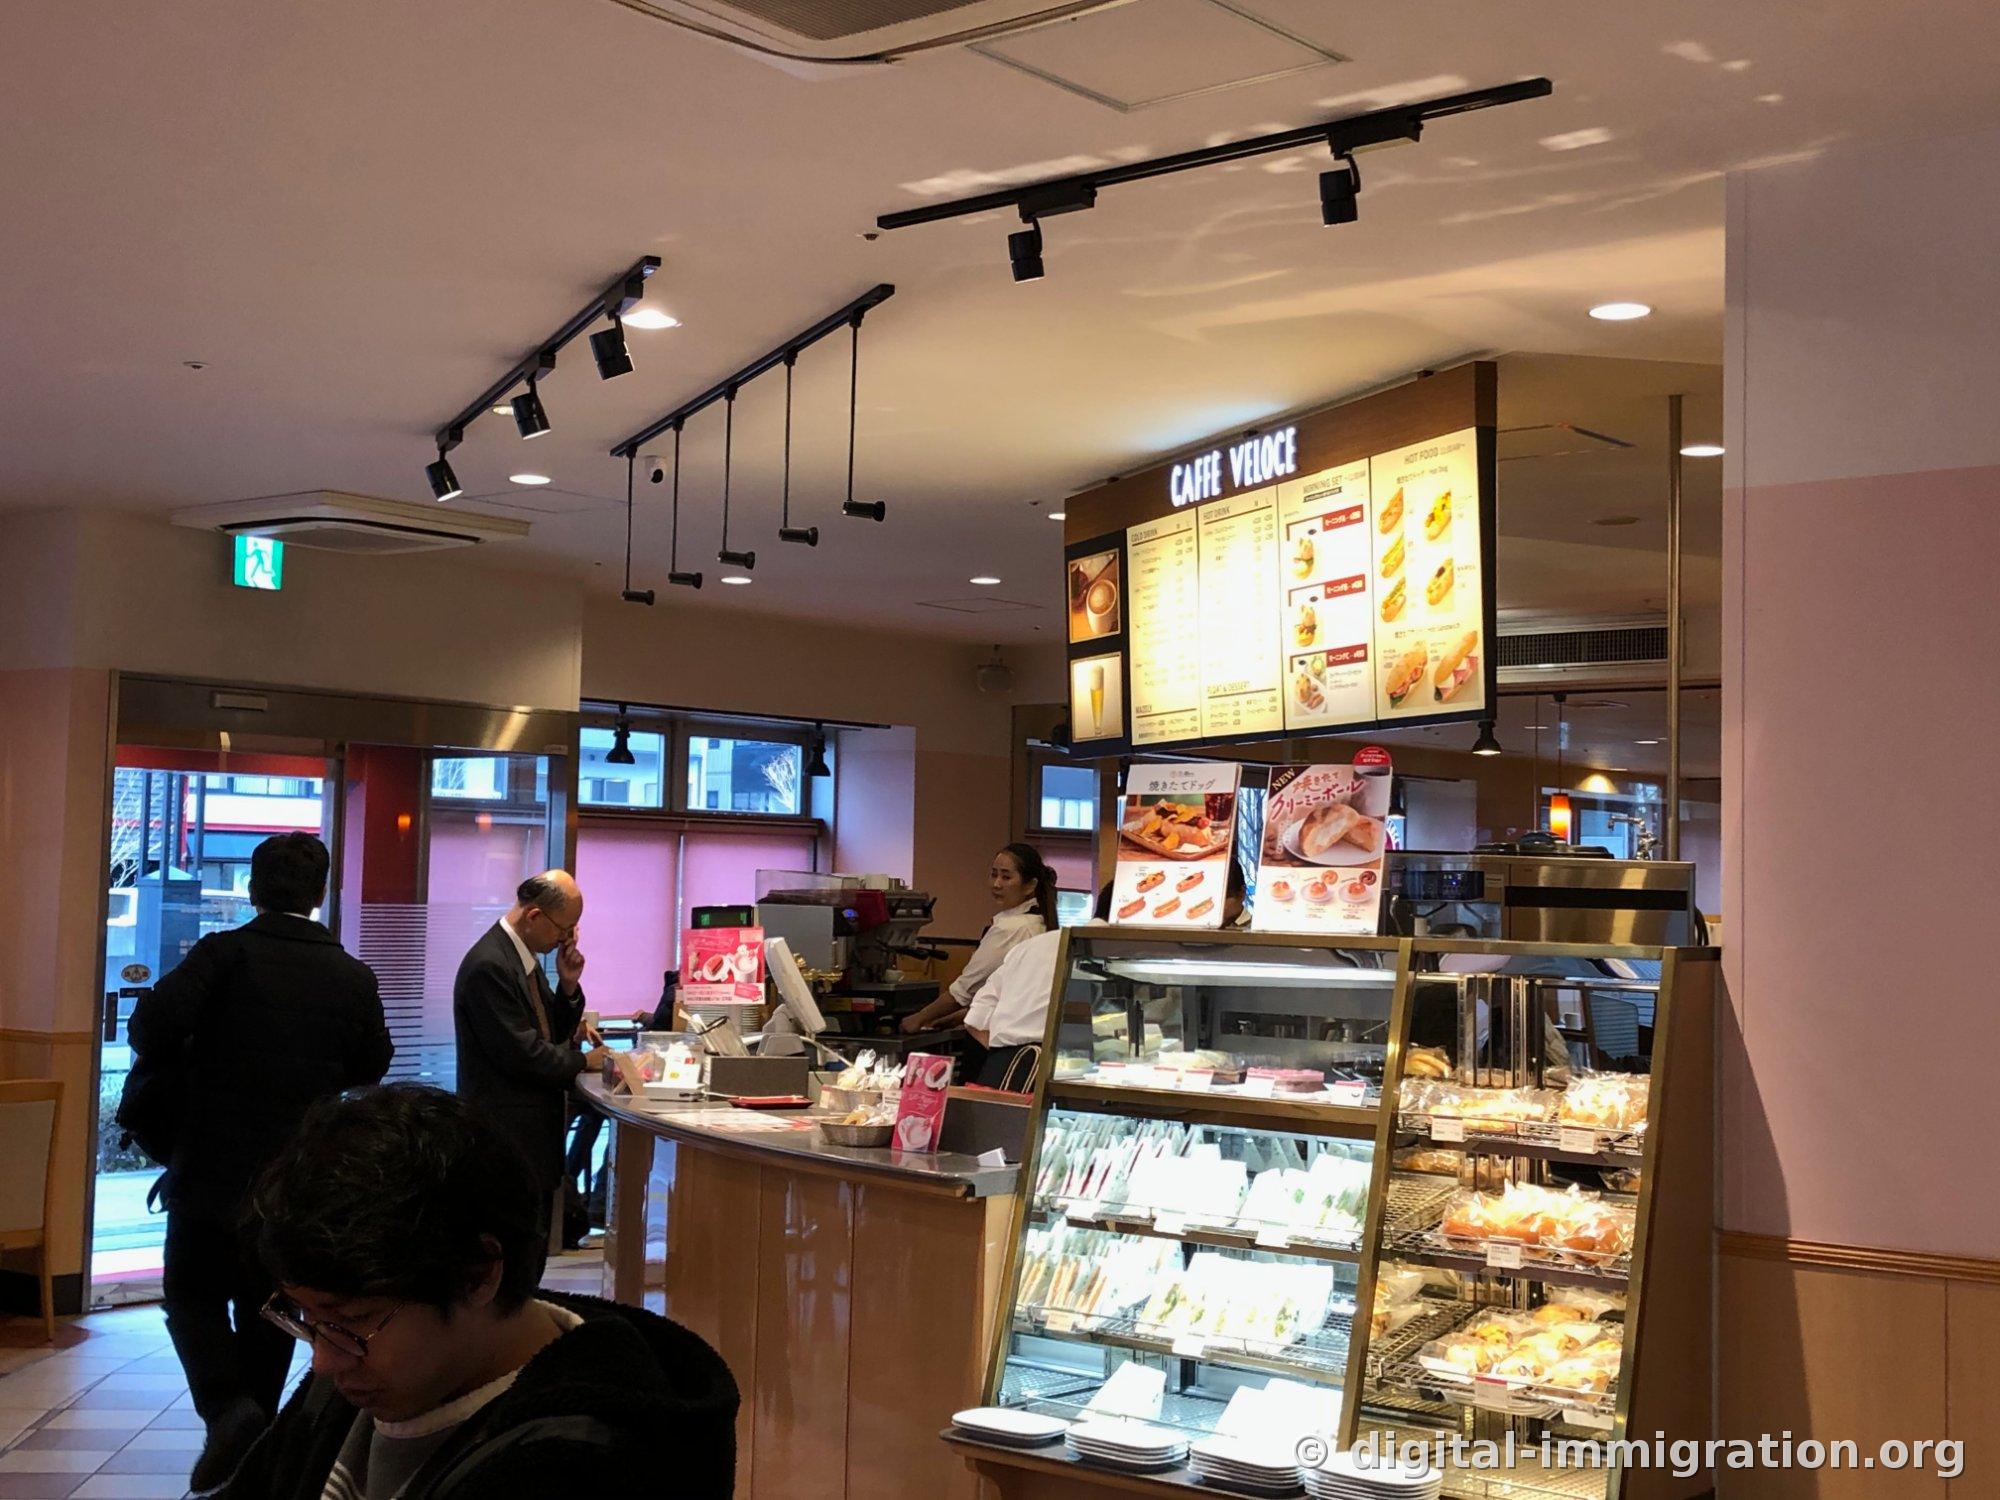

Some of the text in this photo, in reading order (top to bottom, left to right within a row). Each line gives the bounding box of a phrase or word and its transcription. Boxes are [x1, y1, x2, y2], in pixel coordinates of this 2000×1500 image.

[1229, 427, 1297, 488] VELOCE
[1419, 447, 1439, 461] FOOD
[1271, 768, 1296, 791] NEW
[1293, 771, 1340, 794] 焼きたて
[1271, 779, 1366, 821] クリーミーボール
